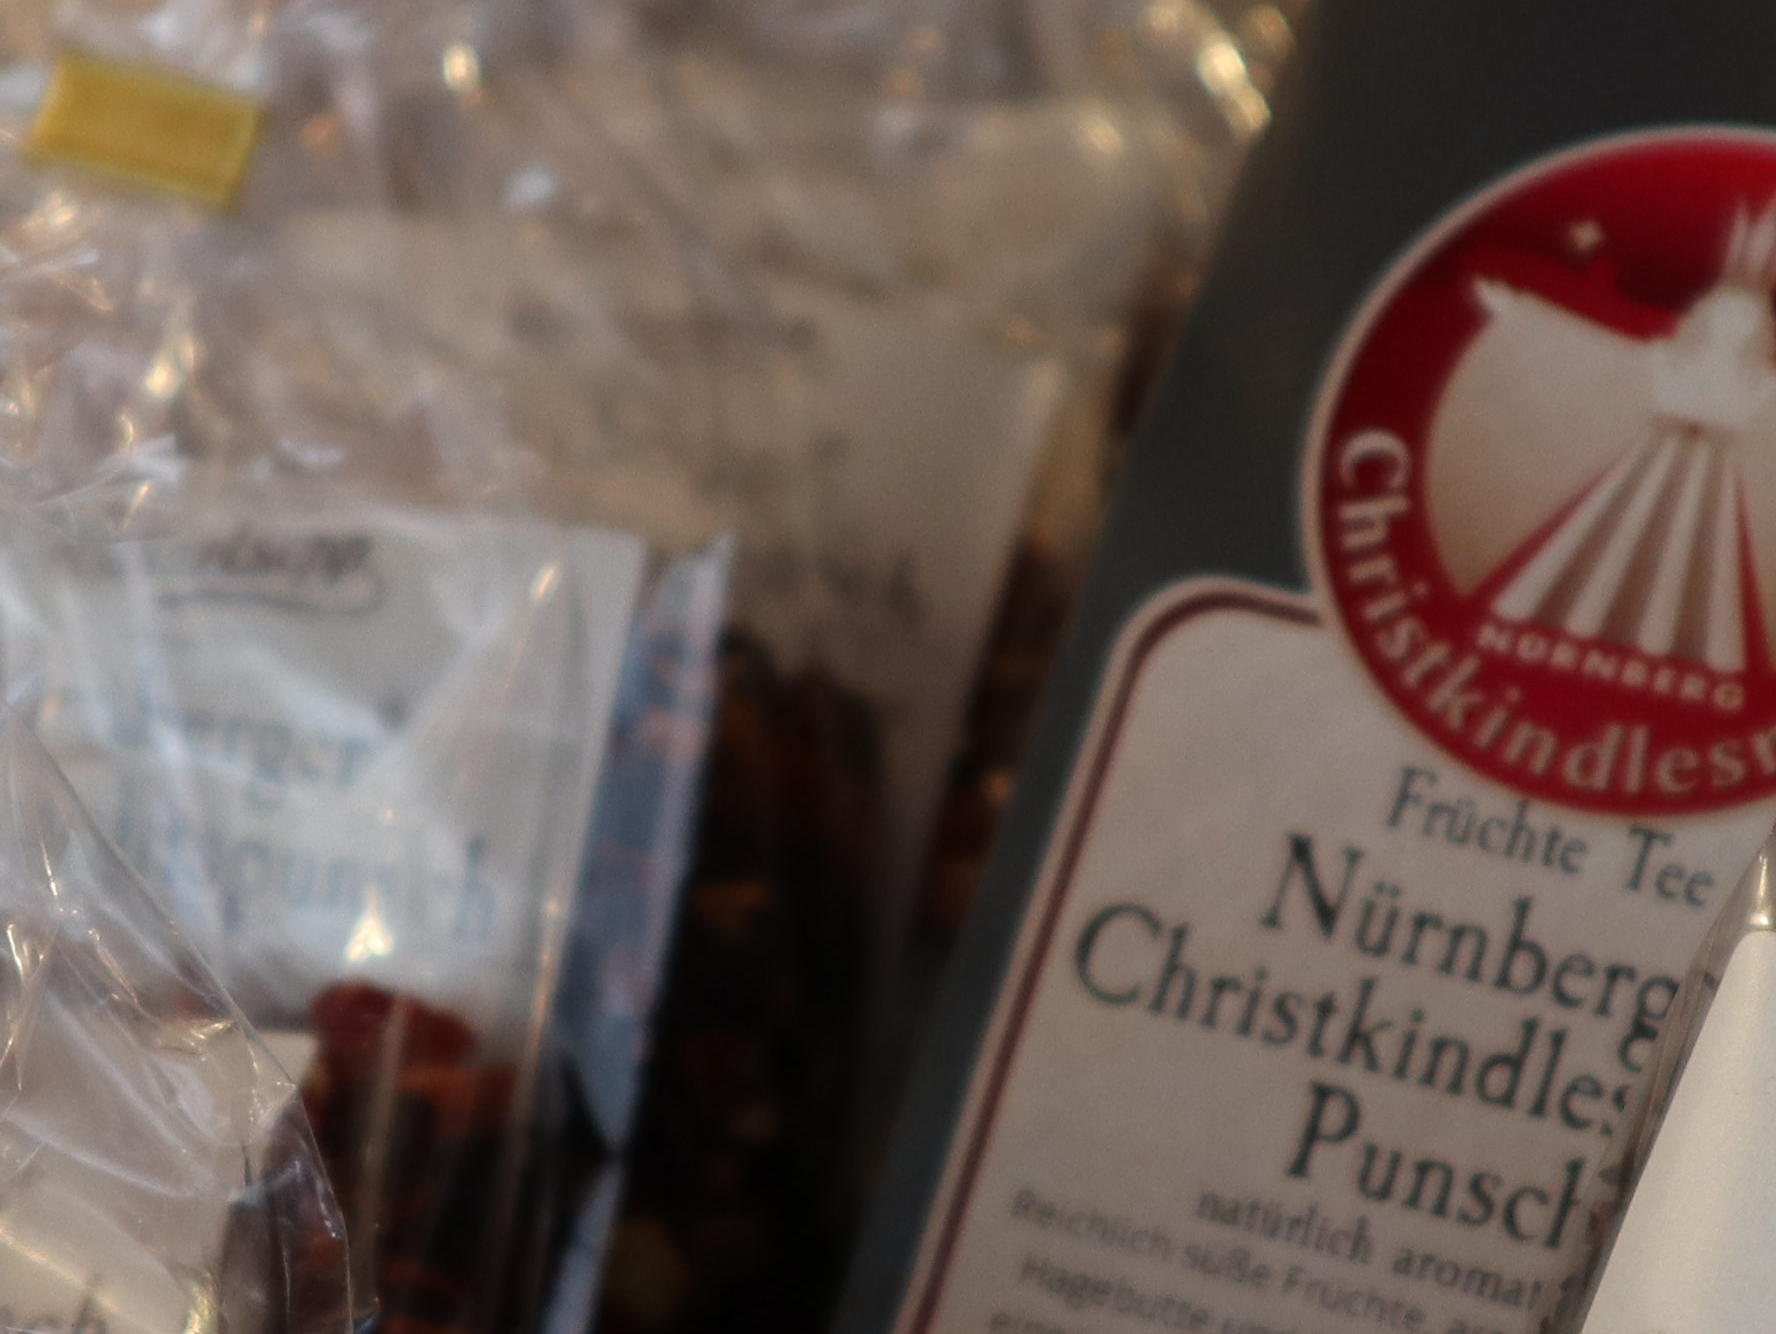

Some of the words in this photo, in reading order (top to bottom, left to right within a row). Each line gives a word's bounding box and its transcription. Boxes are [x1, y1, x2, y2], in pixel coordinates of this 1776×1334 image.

[1386, 765, 1588, 876] Früchte
[1622, 826, 1716, 909] Tee
[1258, 831, 1681, 1075] Nürnberg
